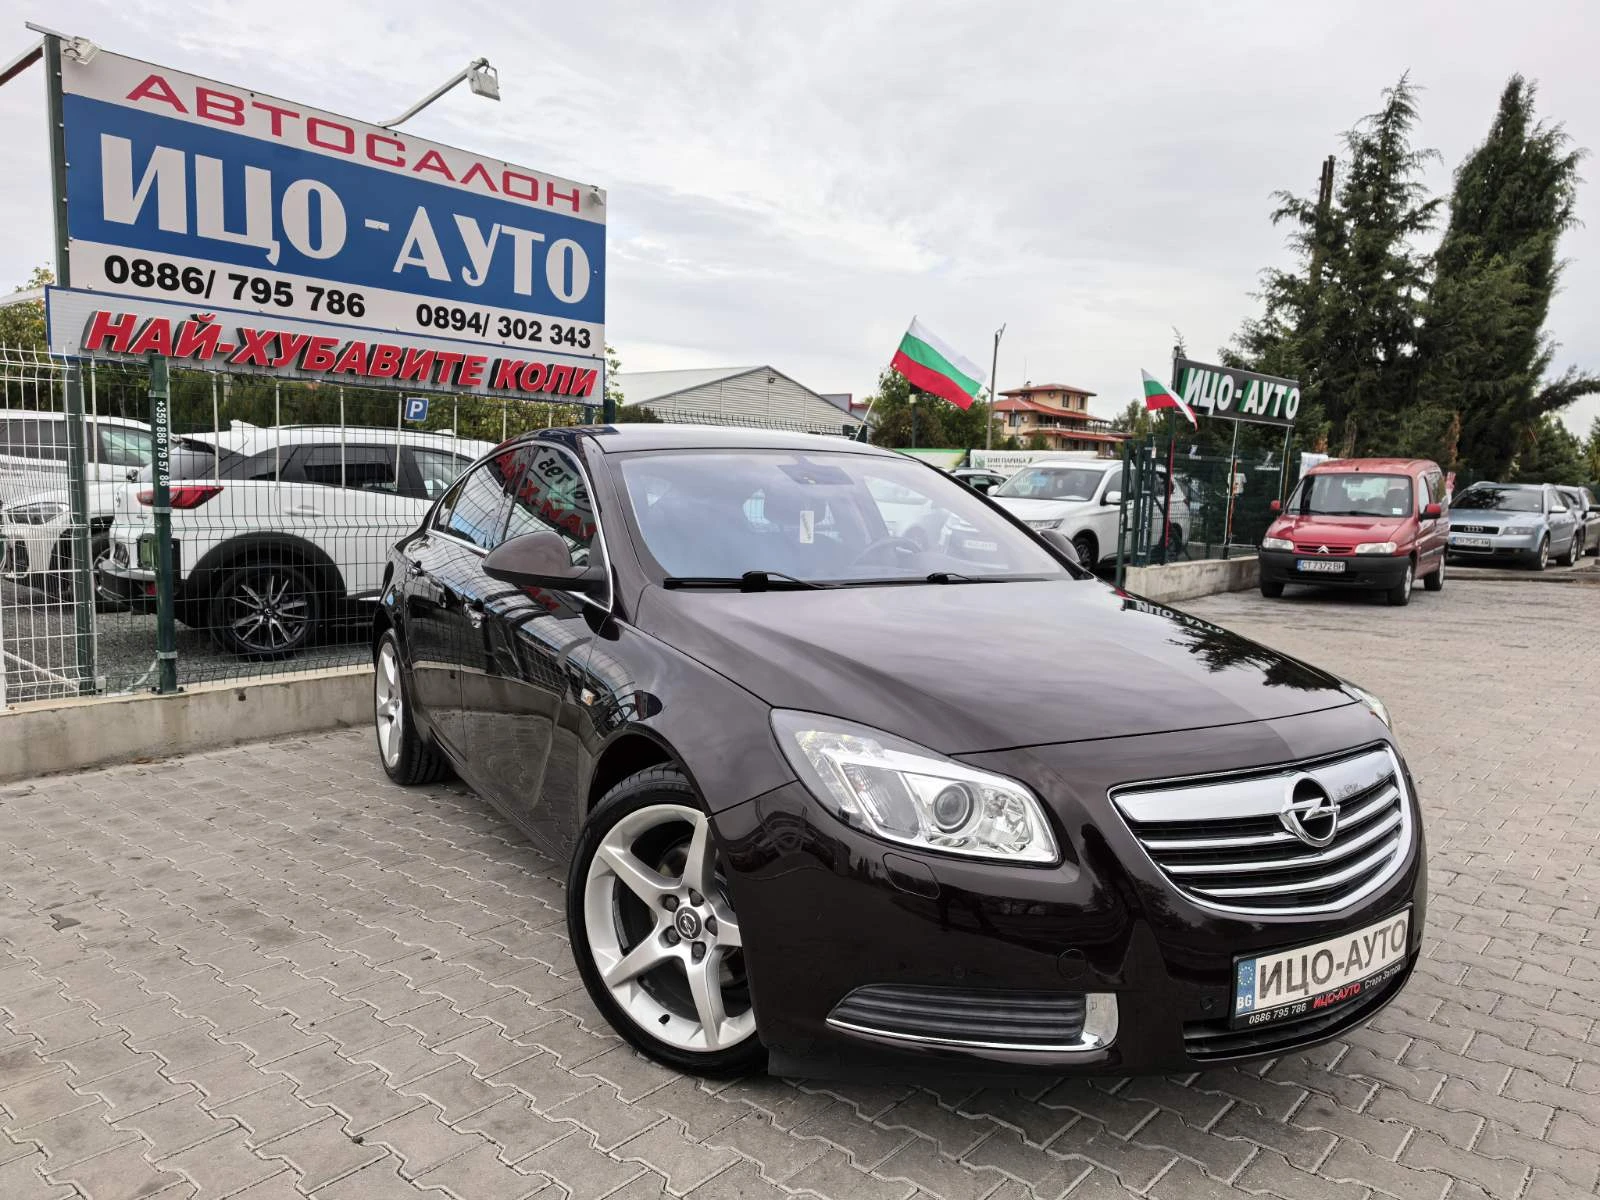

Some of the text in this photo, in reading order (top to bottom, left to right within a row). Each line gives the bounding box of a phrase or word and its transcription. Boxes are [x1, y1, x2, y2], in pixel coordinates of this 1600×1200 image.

[125, 74, 580, 213] АВТОСАЛОН
[104, 255, 366, 318] 0886/ 795 786
[416, 303, 591, 349] 0894/ 302 343
[82, 311, 598, 398] НАЙ-ХУБАВИТЕ КОЛИ
[410, 401, 424, 418] P
[156, 401, 170, 487] +359 886 79 57 86
[1259, 919, 1407, 1000] ИЦО-АУТО
[1236, 994, 1253, 1009] BG
[1249, 1002, 1307, 1025] 0886 795 786
[1312, 983, 1361, 1009] ИЦО-АУТО
